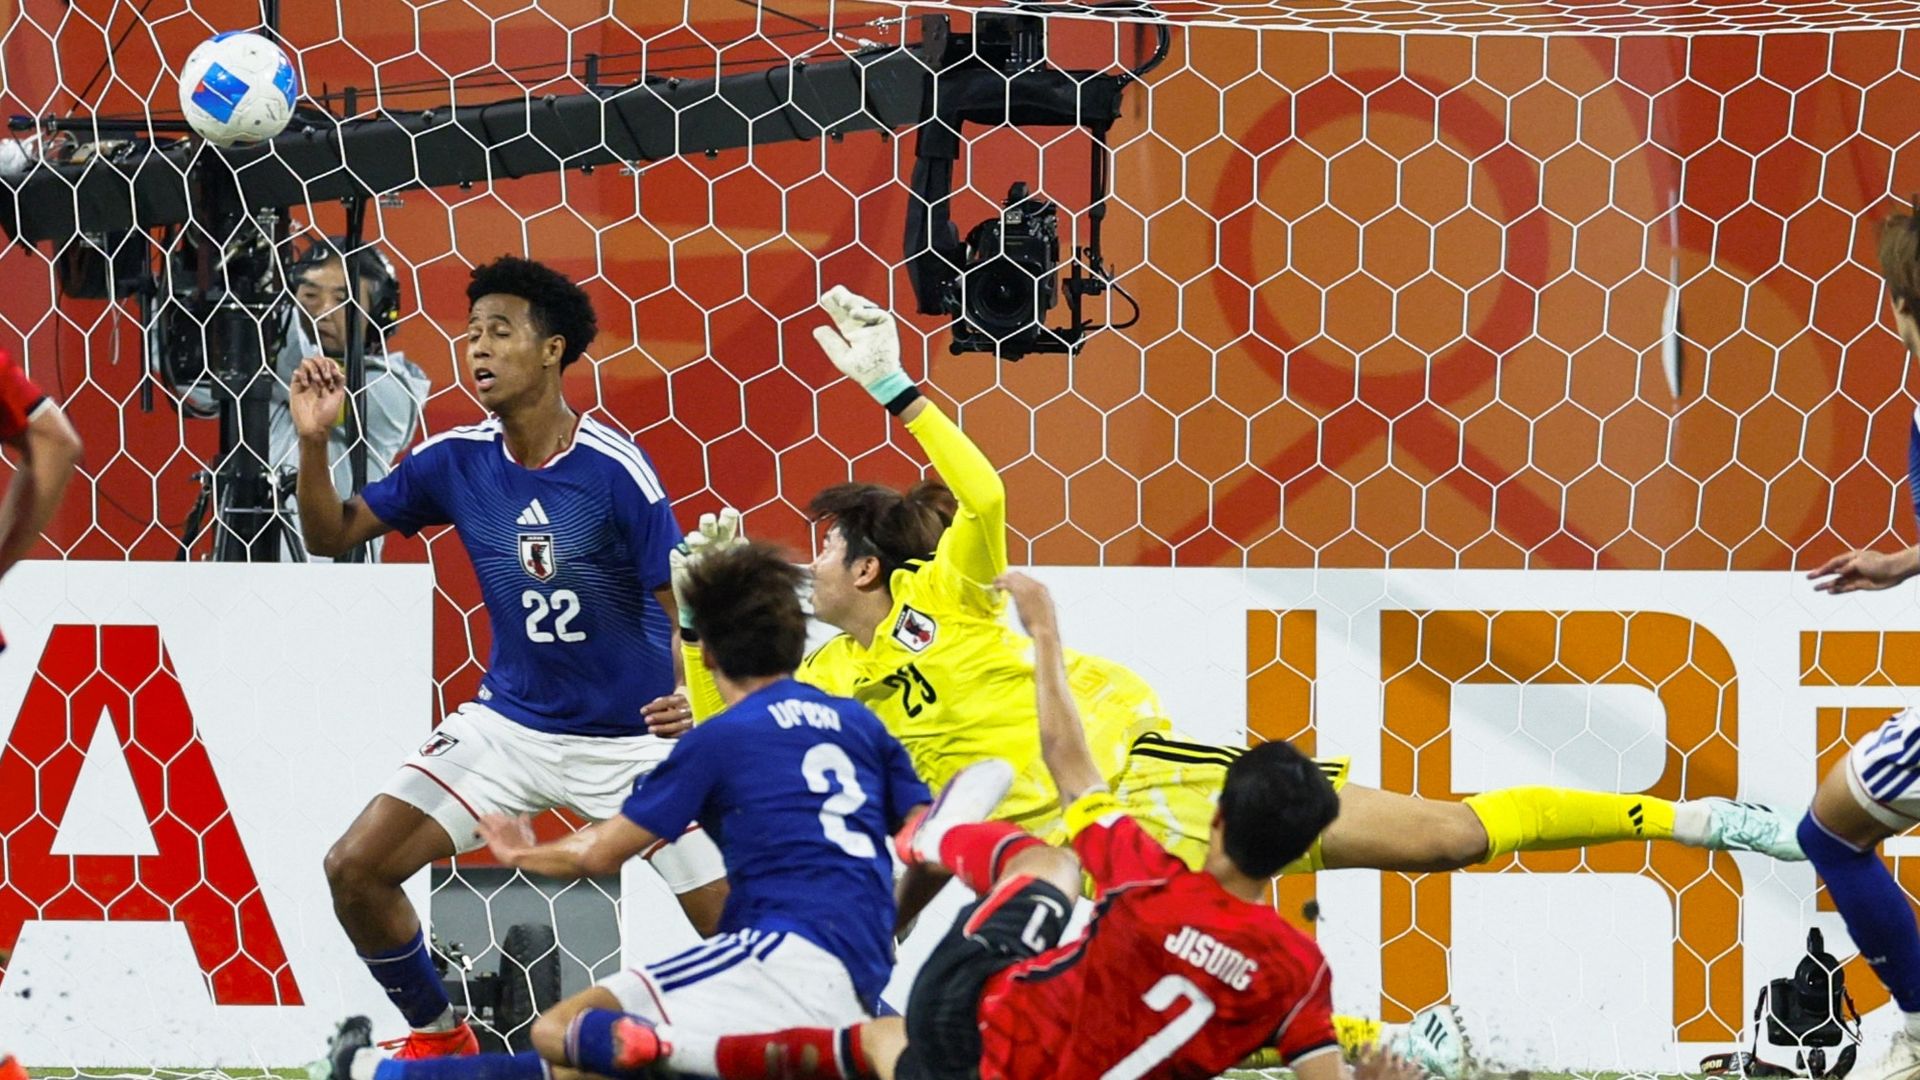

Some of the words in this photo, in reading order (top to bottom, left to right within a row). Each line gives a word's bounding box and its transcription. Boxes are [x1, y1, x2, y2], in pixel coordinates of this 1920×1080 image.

[521, 589, 587, 643] 22
[882, 662, 937, 718] 23
[0, 624, 305, 1006] A
[801, 742, 877, 859] 2
[1163, 925, 1259, 991] JISUNG
[1100, 974, 1216, 1080] 7
